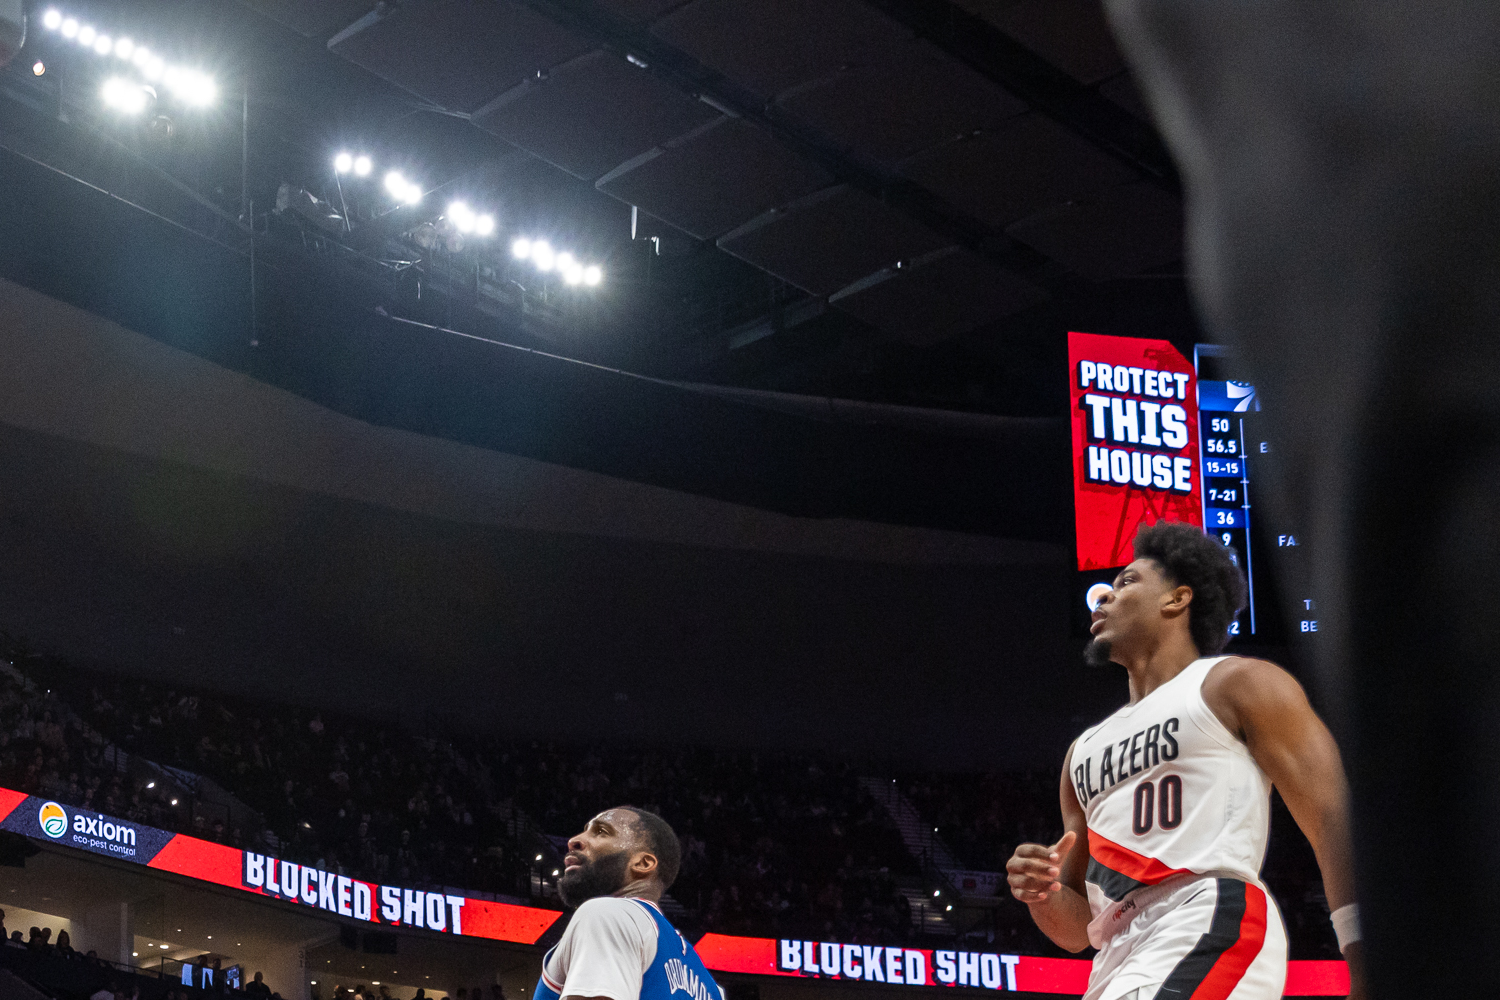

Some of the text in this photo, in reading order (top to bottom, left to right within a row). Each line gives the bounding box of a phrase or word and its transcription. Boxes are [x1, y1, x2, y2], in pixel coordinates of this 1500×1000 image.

[1080, 360, 1190, 400] PROTECT
[1085, 393, 1189, 449] THIS
[1211, 418, 1230, 433] 50
[1206, 439, 1237, 454] 56.5
[1088, 445, 1192, 491] HOUSE
[1206, 461, 1239, 474] 15-15
[1208, 488, 1237, 502] 7-21
[1216, 510, 1235, 525] 36
[1222, 533, 1232, 546] 9
[1073, 717, 1180, 809] BLAZERS
[1132, 774, 1183, 837] 00
[72, 813, 136, 847] axiom
[72, 834, 136, 857] eco-pest control
[246, 851, 466, 936] BLOCKED SHOT
[781, 938, 1020, 992] BLOCKED SHOT
